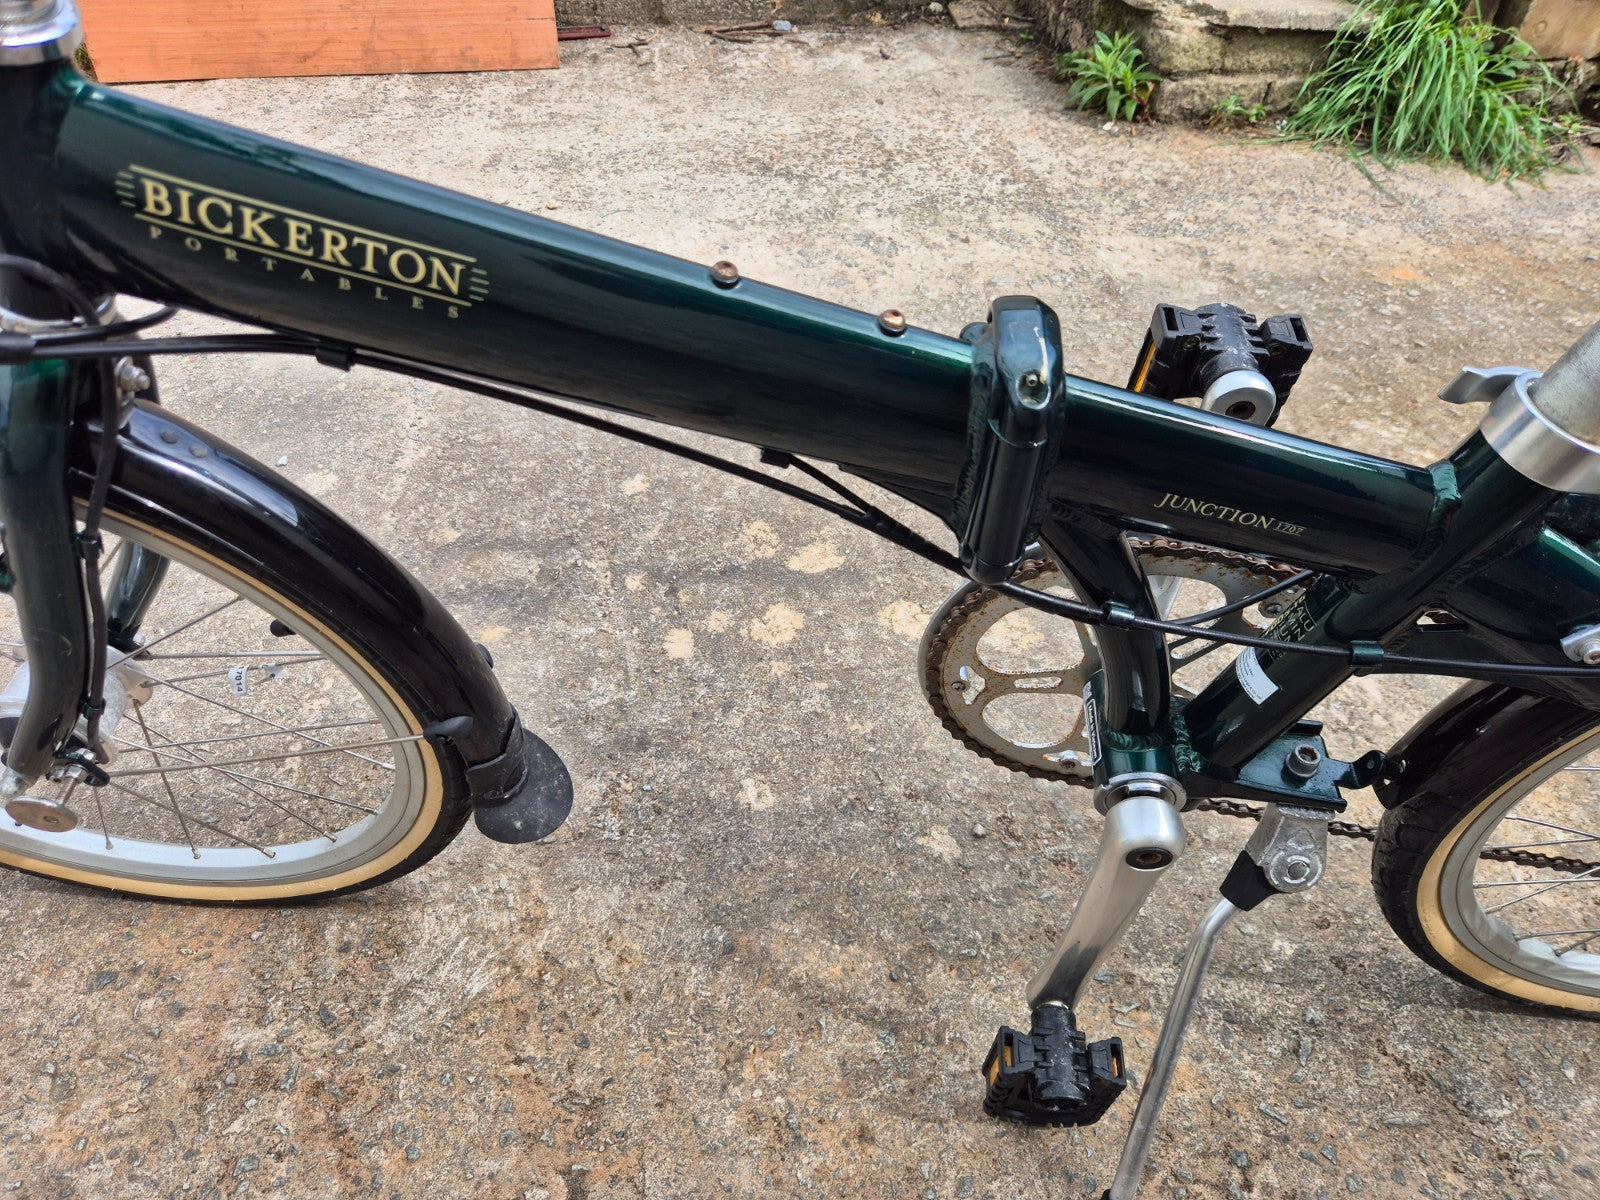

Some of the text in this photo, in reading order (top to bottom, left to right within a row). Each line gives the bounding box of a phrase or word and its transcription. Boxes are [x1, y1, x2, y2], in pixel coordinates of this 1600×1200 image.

[141, 177, 466, 296] BICKERTON
[149, 226, 460, 319] PORTABLES
[1154, 493, 1276, 529] JUNCTION
[1297, 606, 1315, 632] ALU
